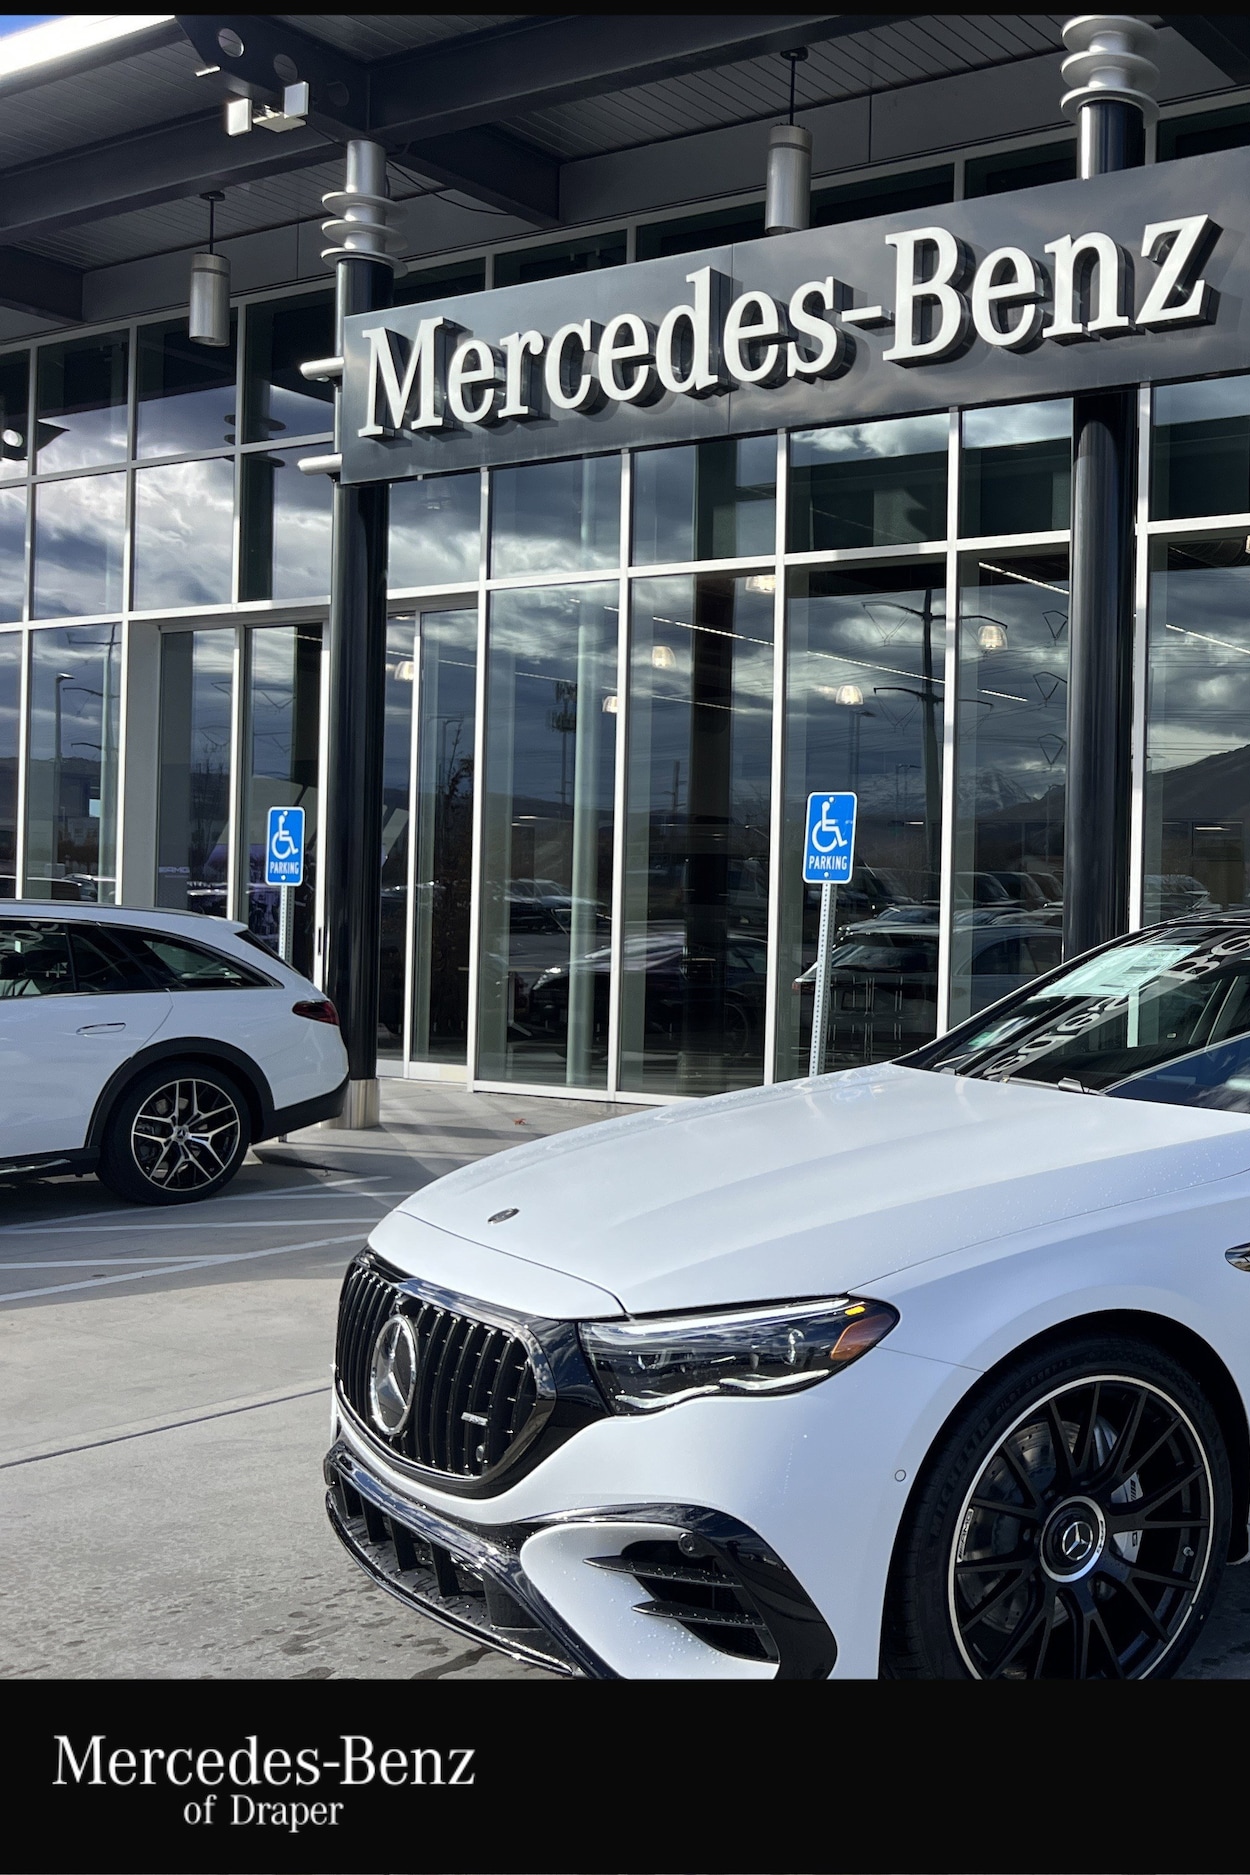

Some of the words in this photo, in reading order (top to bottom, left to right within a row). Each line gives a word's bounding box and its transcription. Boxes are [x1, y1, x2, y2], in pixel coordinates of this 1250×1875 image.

[358, 214, 1210, 438] Mercedes-Benz
[269, 861, 299, 875] PARKING
[808, 855, 848, 870] PARKING
